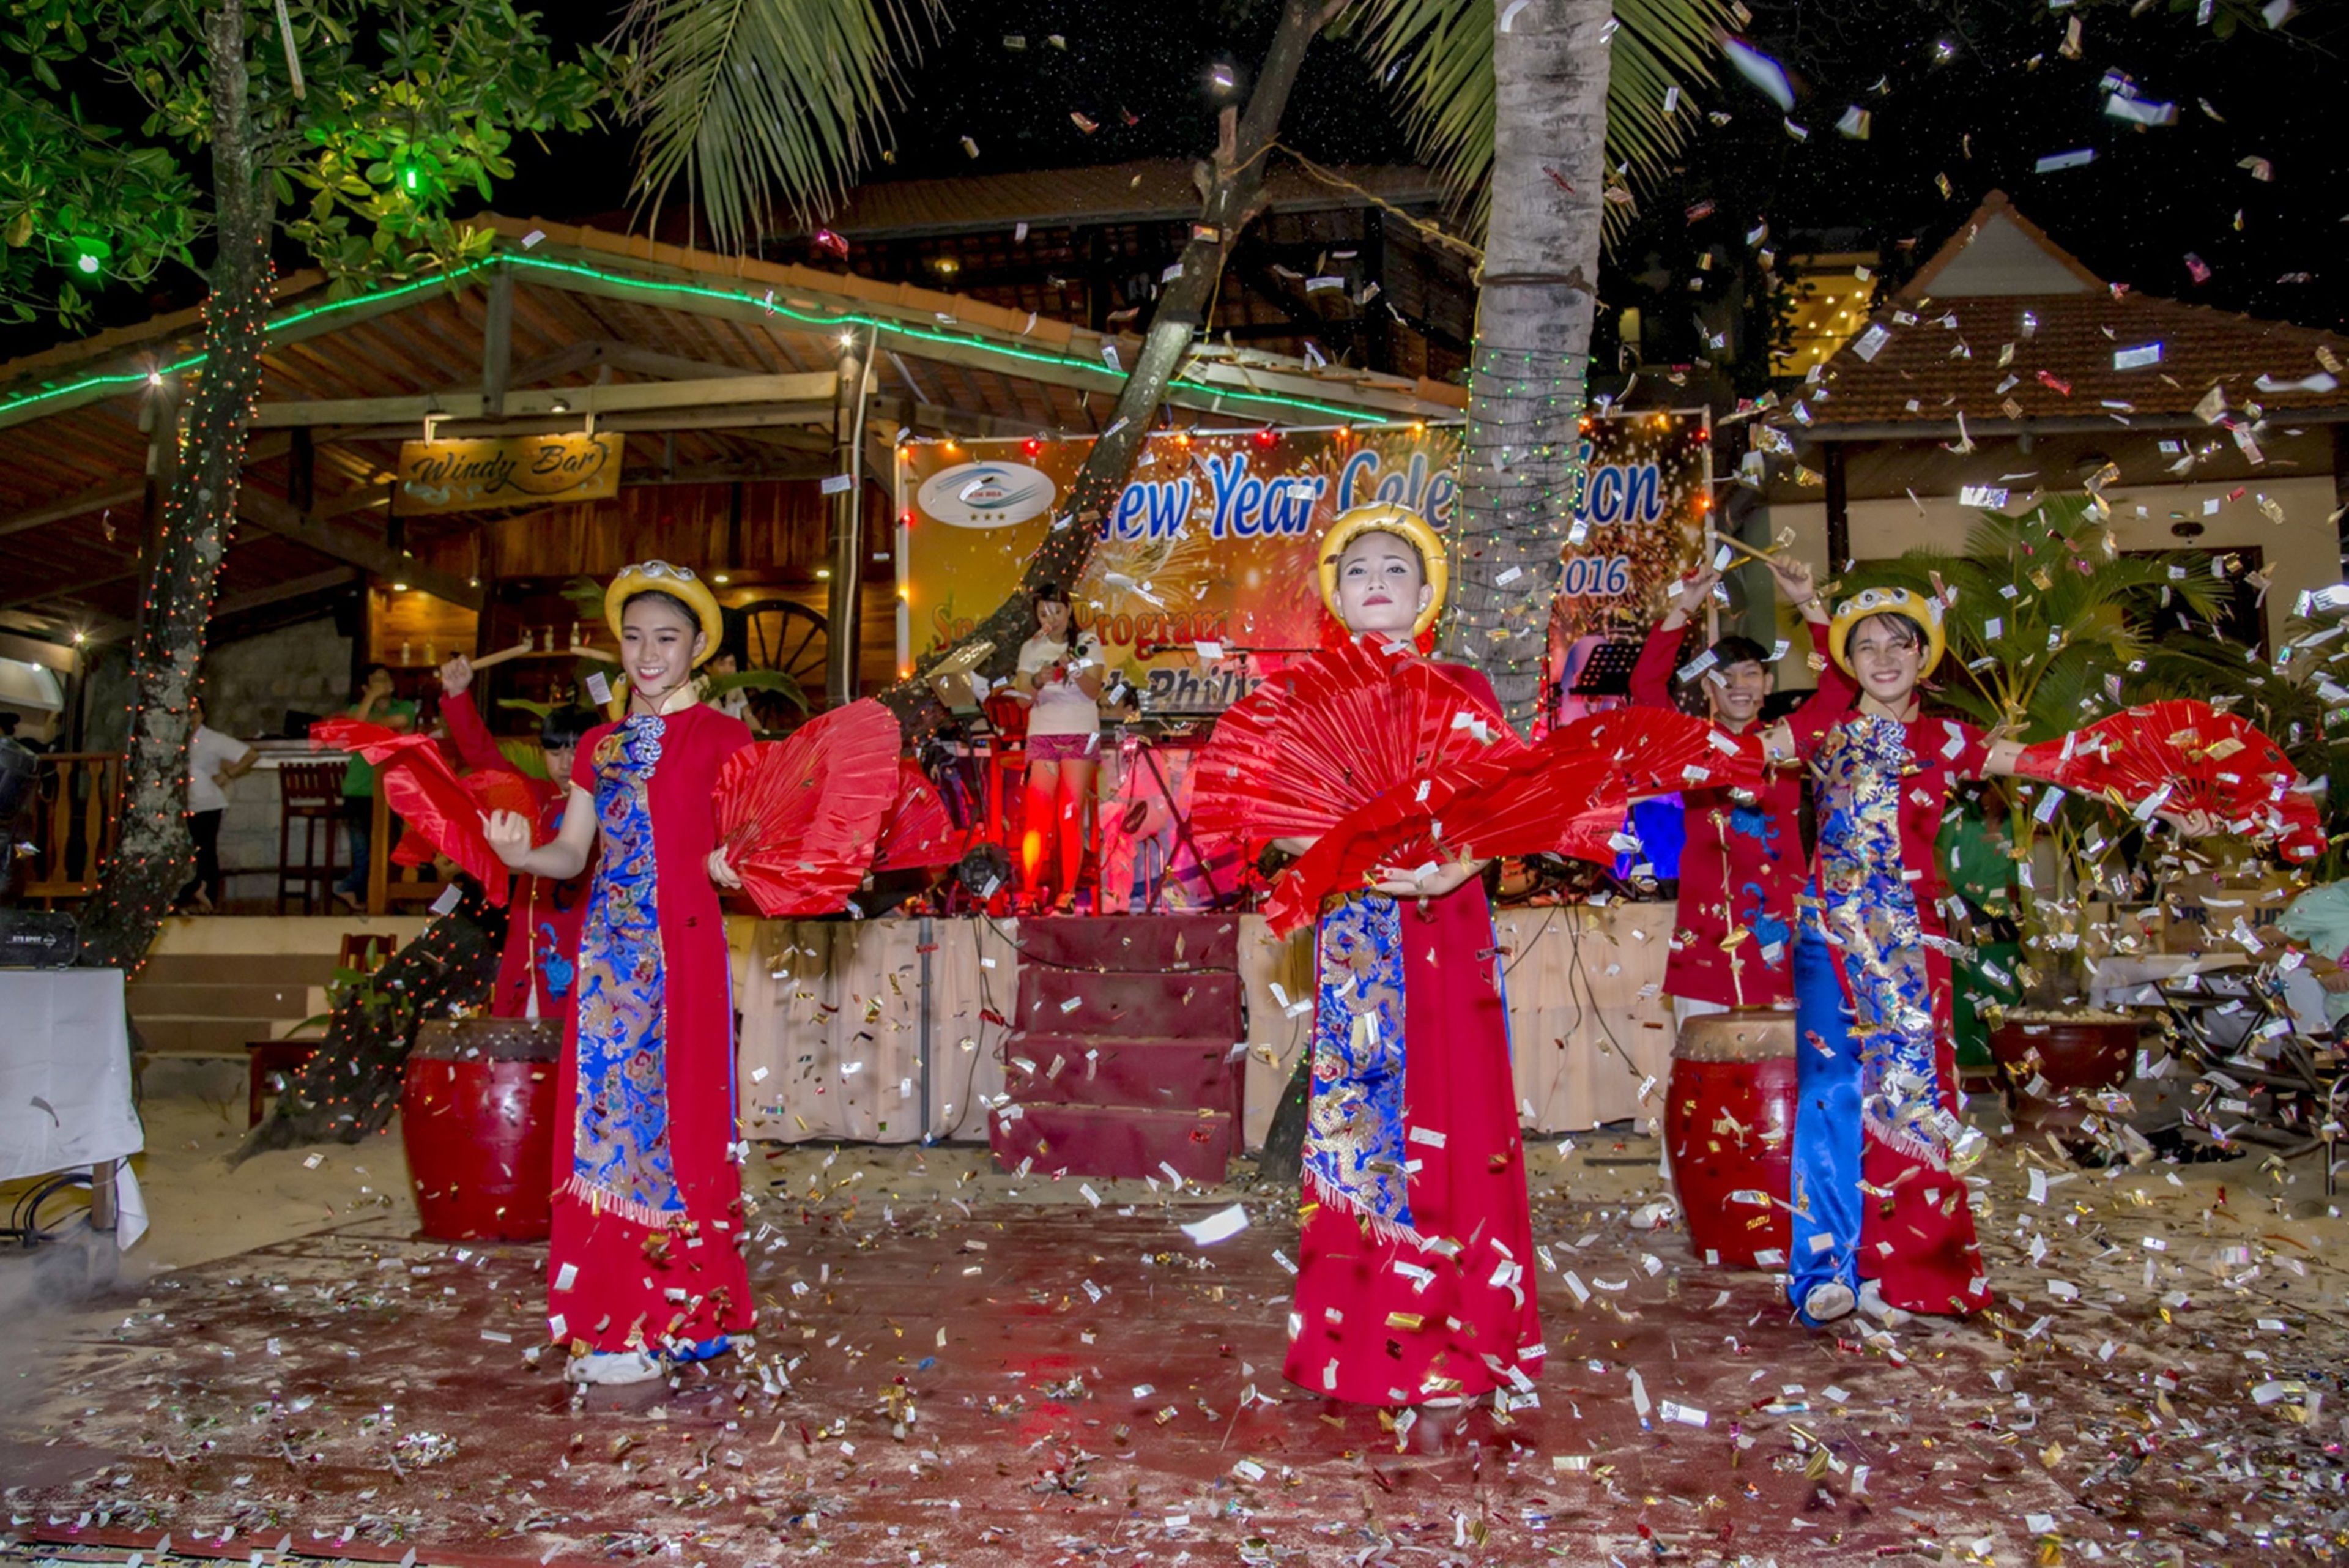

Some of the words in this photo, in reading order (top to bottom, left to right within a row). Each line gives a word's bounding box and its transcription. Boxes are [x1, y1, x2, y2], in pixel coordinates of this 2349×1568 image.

[410, 450, 517, 494] Windy
[530, 442, 603, 476] Bar
[1099, 477, 1192, 541] ew
[1208, 451, 1325, 538] Year
[1552, 557, 1627, 593] 016
